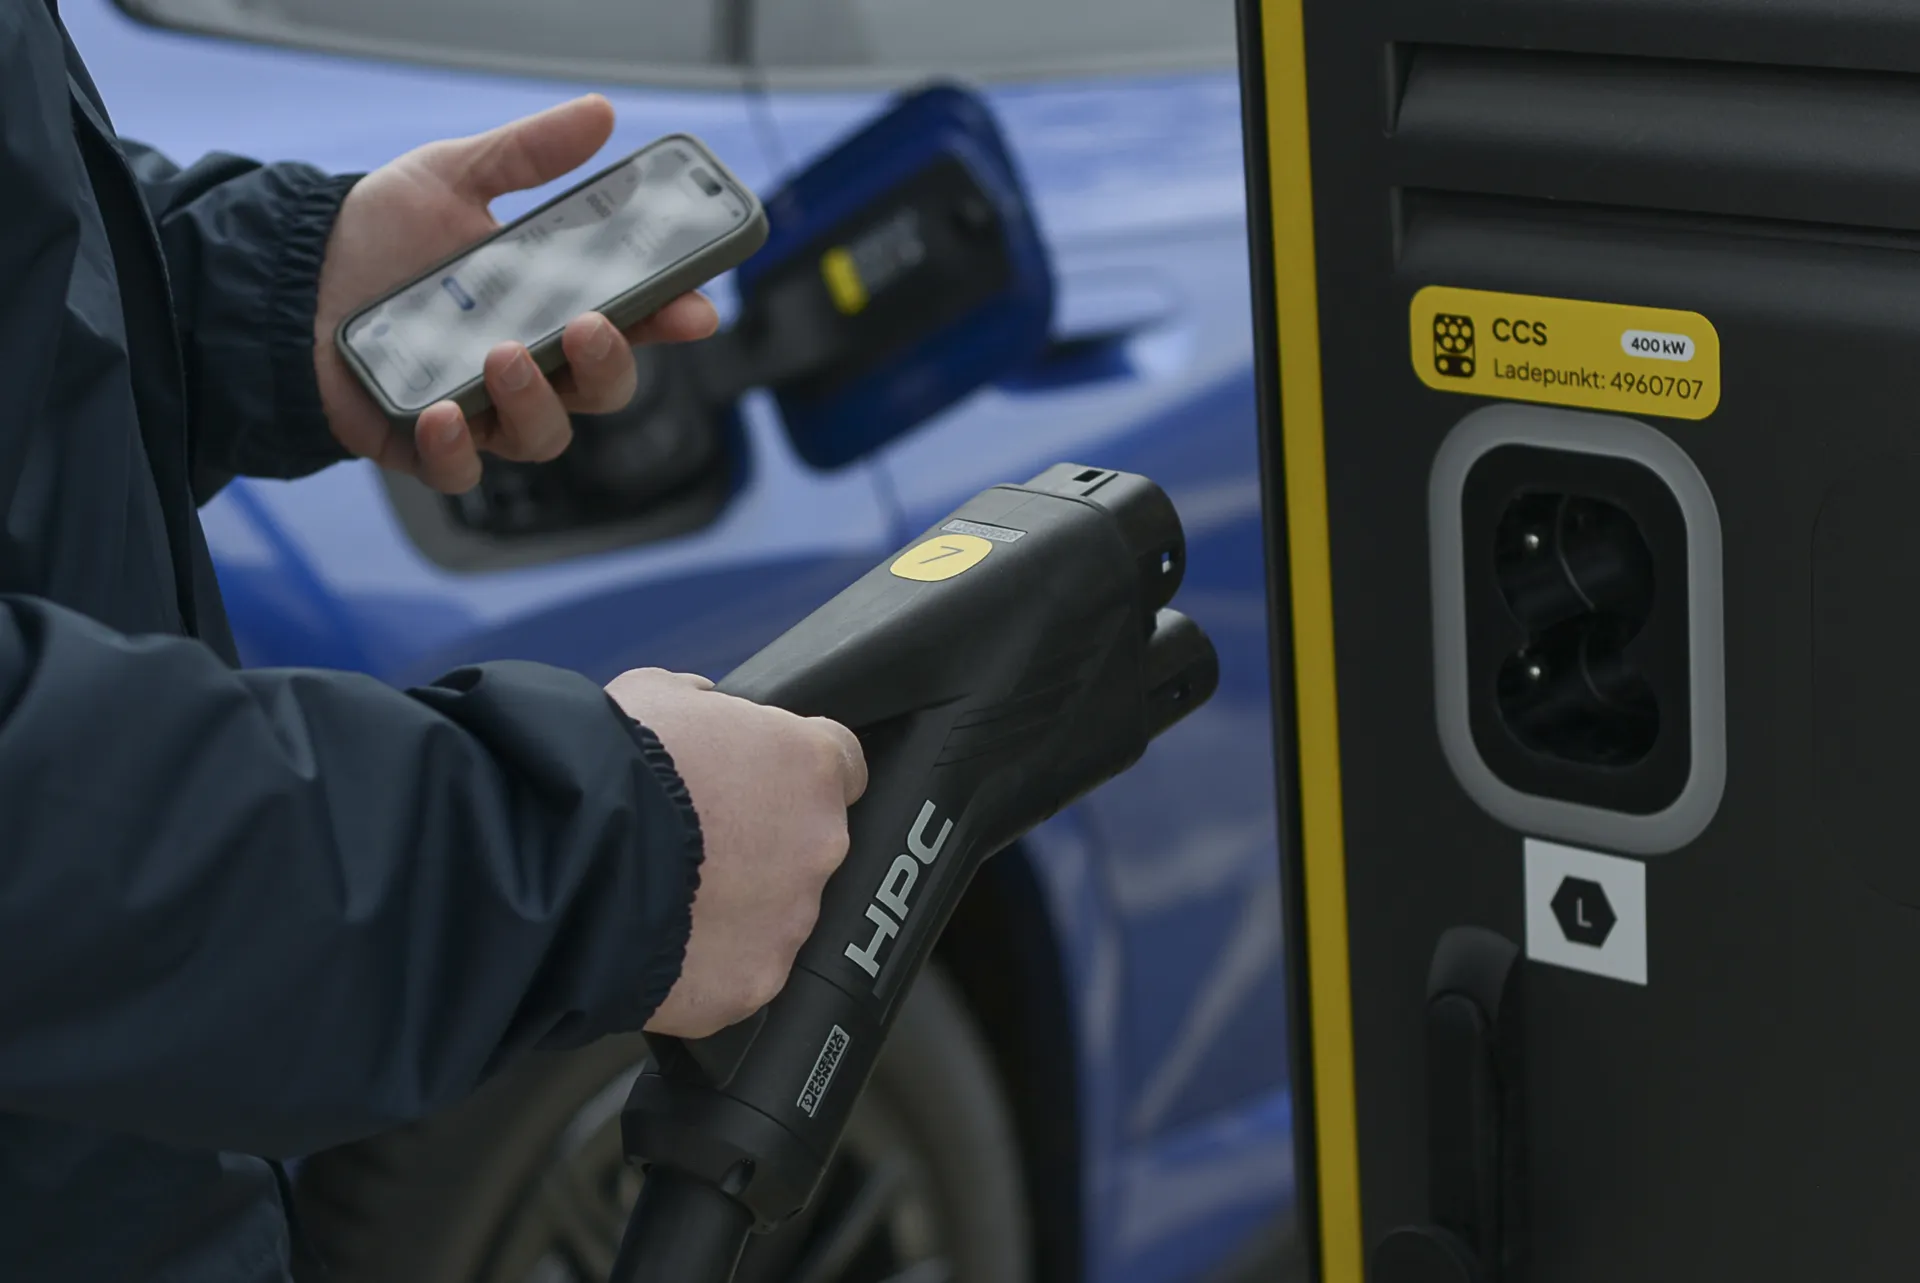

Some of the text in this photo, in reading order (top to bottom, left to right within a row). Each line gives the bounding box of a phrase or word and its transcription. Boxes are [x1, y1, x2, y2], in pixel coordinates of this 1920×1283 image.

[1492, 318, 1548, 346] CCS
[1631, 337, 1686, 355] 400 kW
[1494, 358, 1704, 399] Ladepunkt: 4960707
[919, 545, 965, 564] 7
[844, 799, 954, 978] HPC
[1576, 897, 1593, 928] L
[814, 1034, 846, 1096] CONTACT
